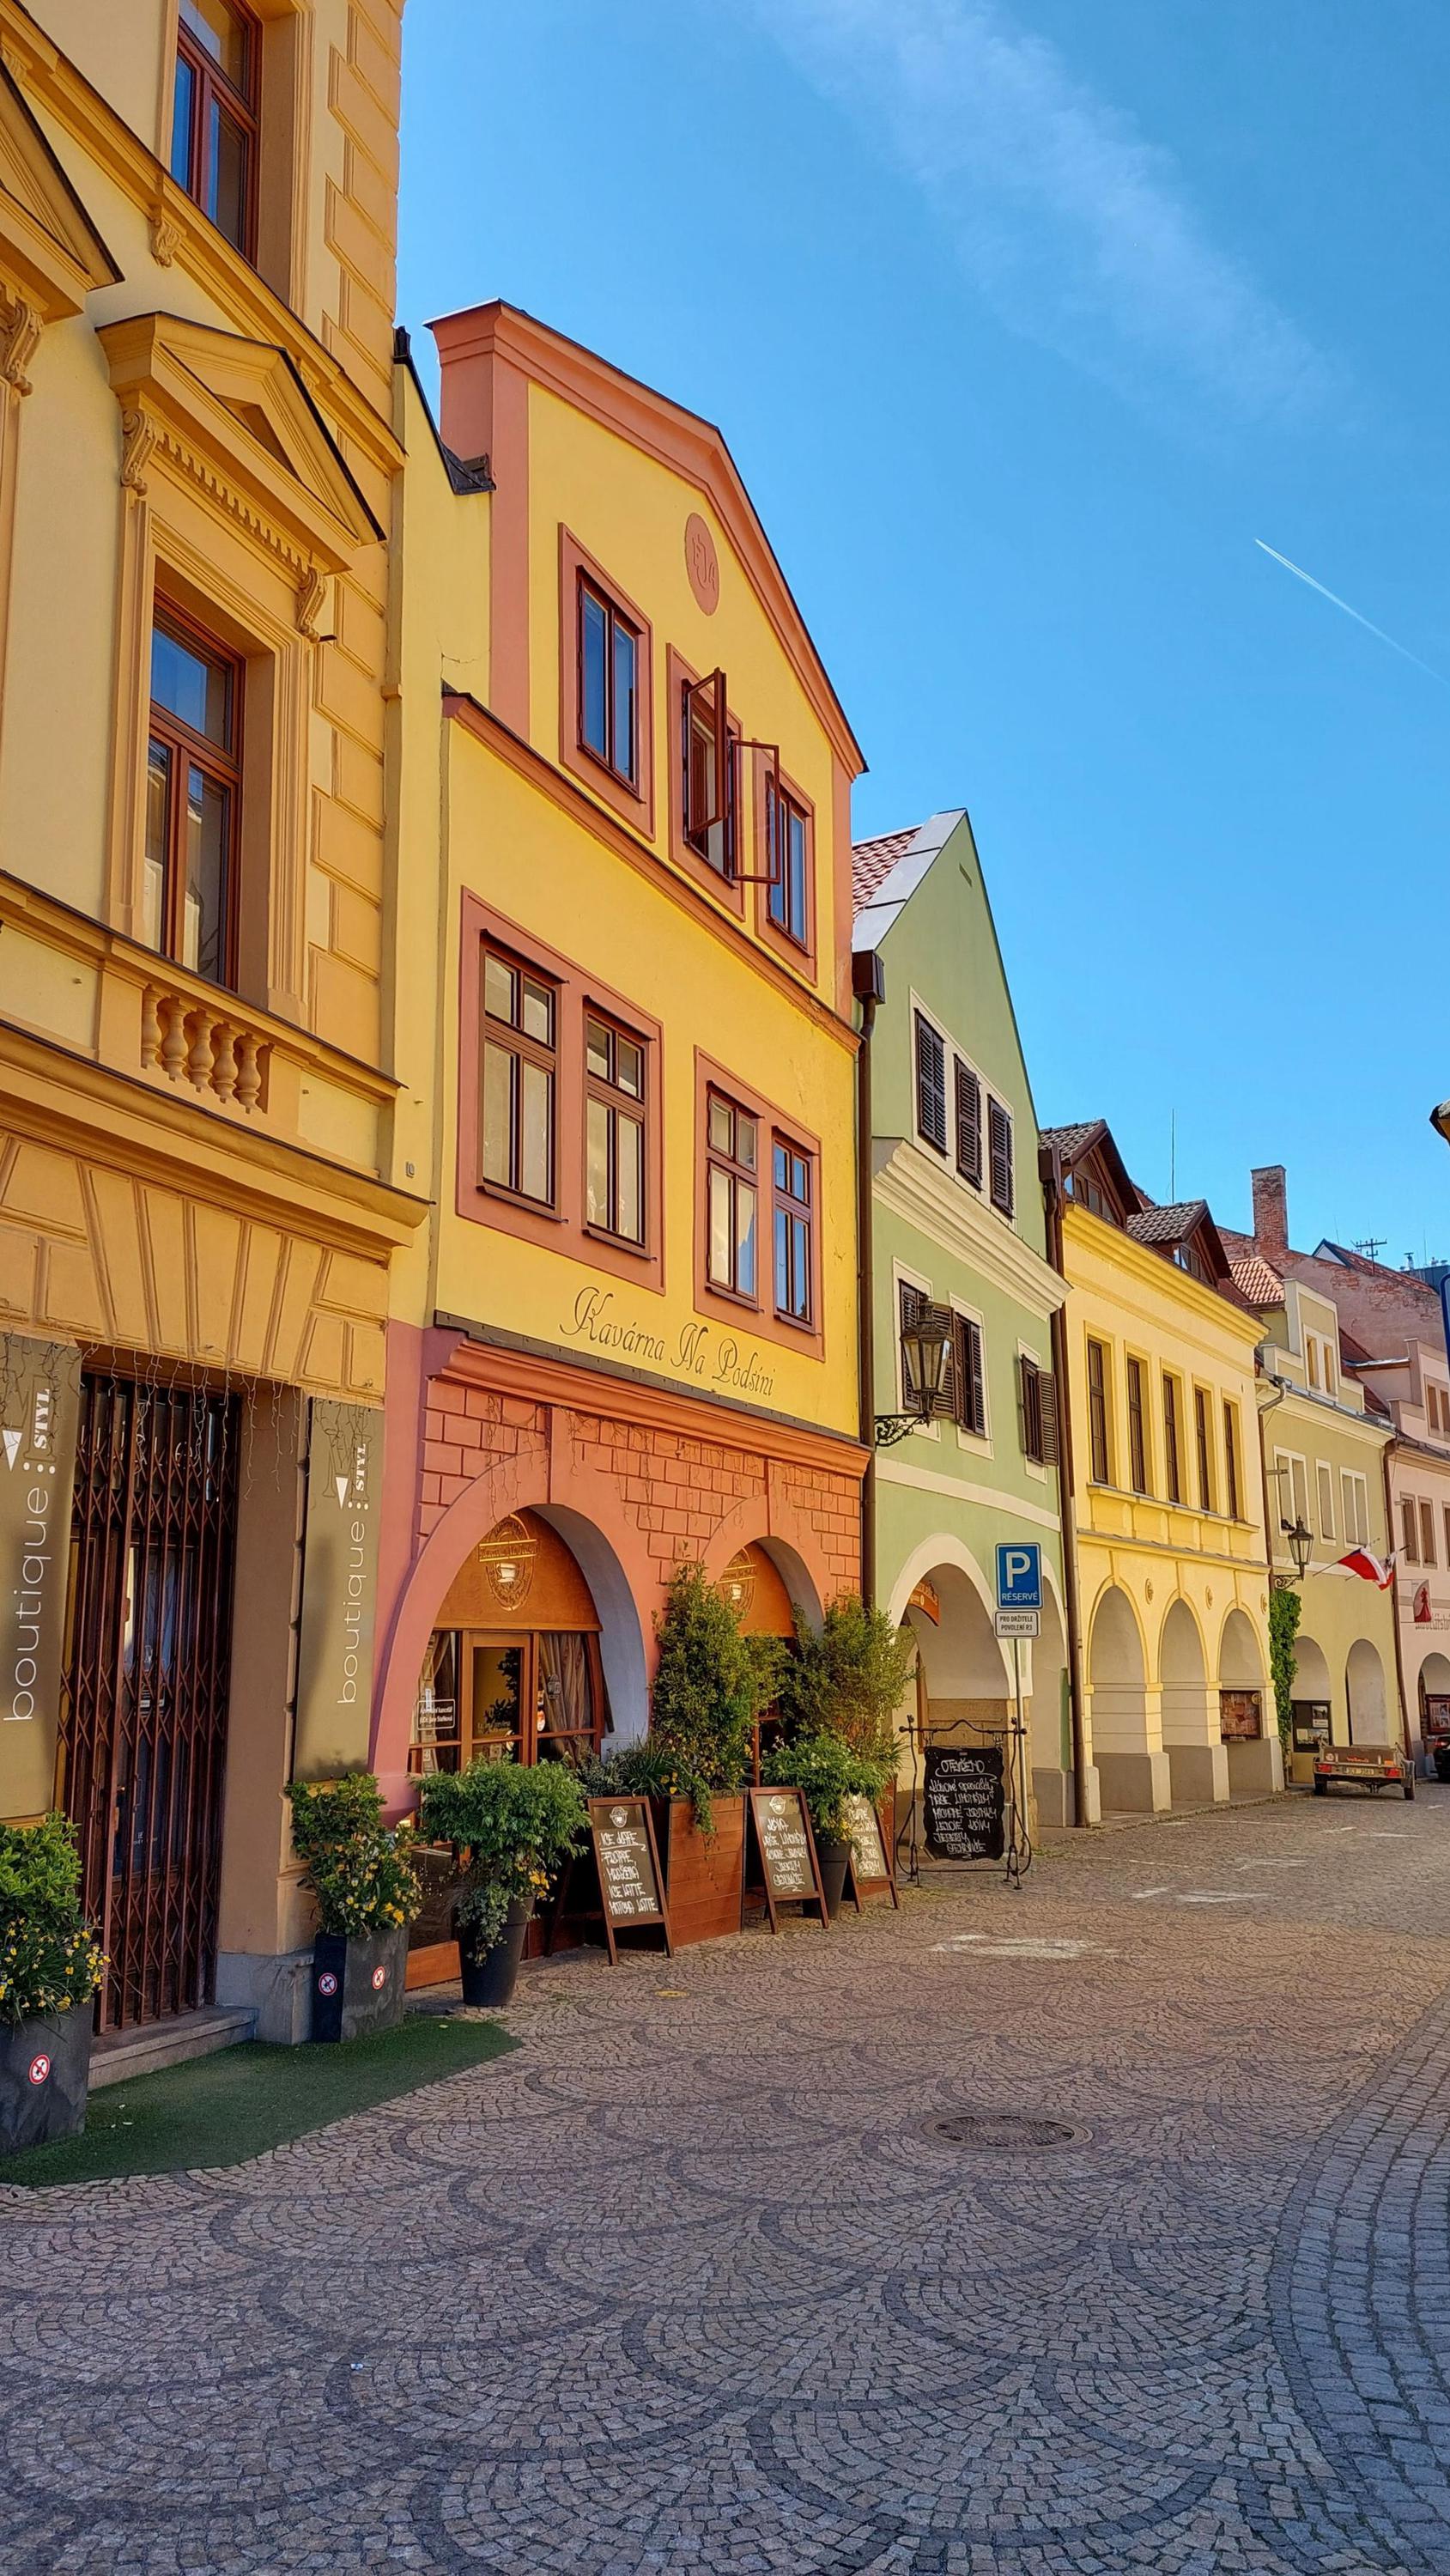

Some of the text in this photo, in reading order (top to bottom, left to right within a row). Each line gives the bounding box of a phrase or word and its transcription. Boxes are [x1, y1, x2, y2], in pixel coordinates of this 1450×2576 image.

[559, 1285, 665, 1361] Kavárna
[670, 1321, 709, 1375] Na
[33, 1388, 51, 1449] STYL
[355, 1443, 367, 1492] STYL
[1001, 1590, 1039, 1601] RÉSERVÉ
[1006, 1552, 1030, 1589] P
[4, 1486, 52, 1721] boutique
[337, 1520, 367, 1704] boutique
[608, 1884, 623, 1899] ICE
